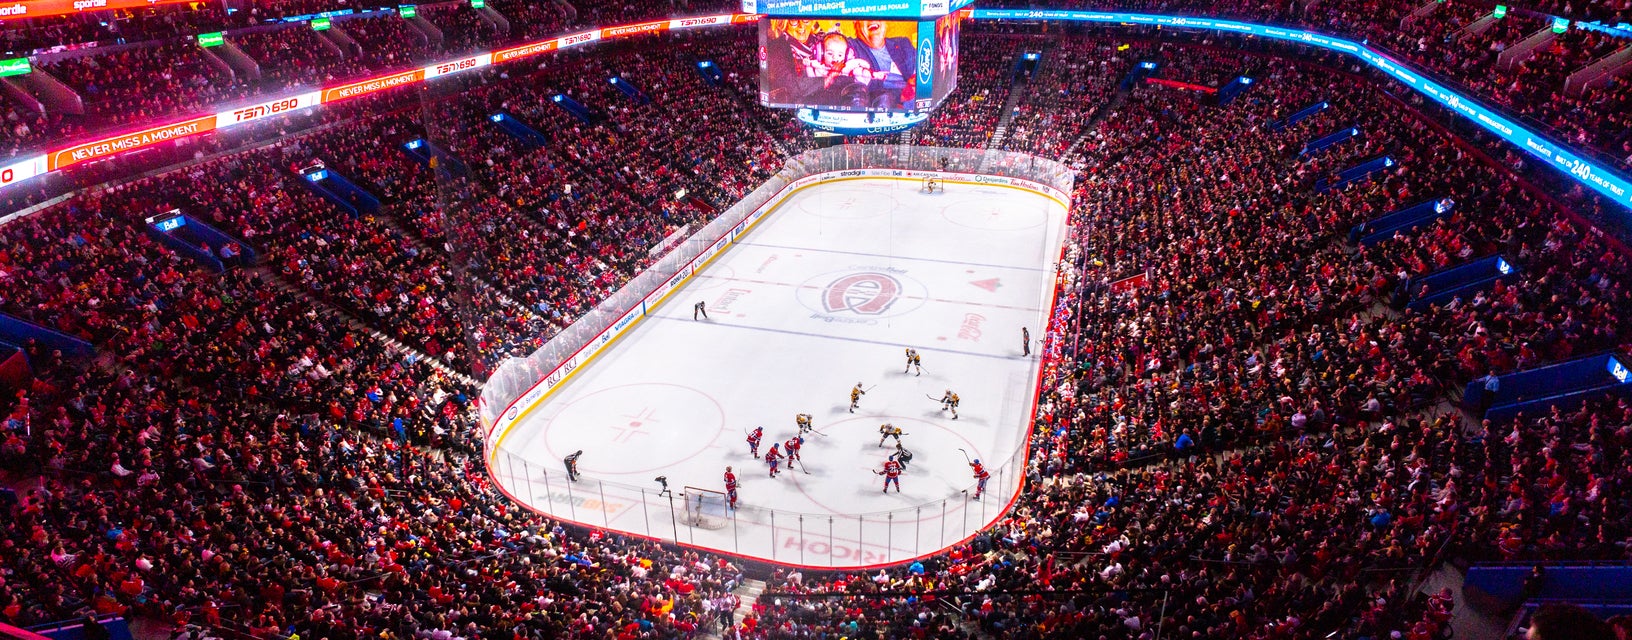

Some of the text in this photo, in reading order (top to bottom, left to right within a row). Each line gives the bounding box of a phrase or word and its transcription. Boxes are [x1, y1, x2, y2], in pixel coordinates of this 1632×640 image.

[0, 4, 26, 16] ordle
[580, 33, 592, 42] 690
[436, 58, 476, 74] TSN 690
[920, 48, 931, 76] Ford
[339, 86, 364, 97] NEVER
[364, 82, 380, 92] MISS
[386, 74, 414, 86] MOMENT
[234, 98, 298, 122] TSN 690
[72, 123, 198, 160] NEVER MISS A MOMENT
[312, 171, 322, 181] Bell
[1010, 178, 1020, 186] Tim
[1570, 159, 1591, 180] 240
[1590, 173, 1604, 186] YEARS
[1610, 184, 1625, 196] TRUST
[164, 218, 178, 230] Bell
[670, 274, 682, 287] RONA
[614, 313, 634, 331] VIAGRA
[602, 331, 611, 344] Bell
[1612, 362, 1629, 381] Bell
[784, 536, 886, 564] RICOH
